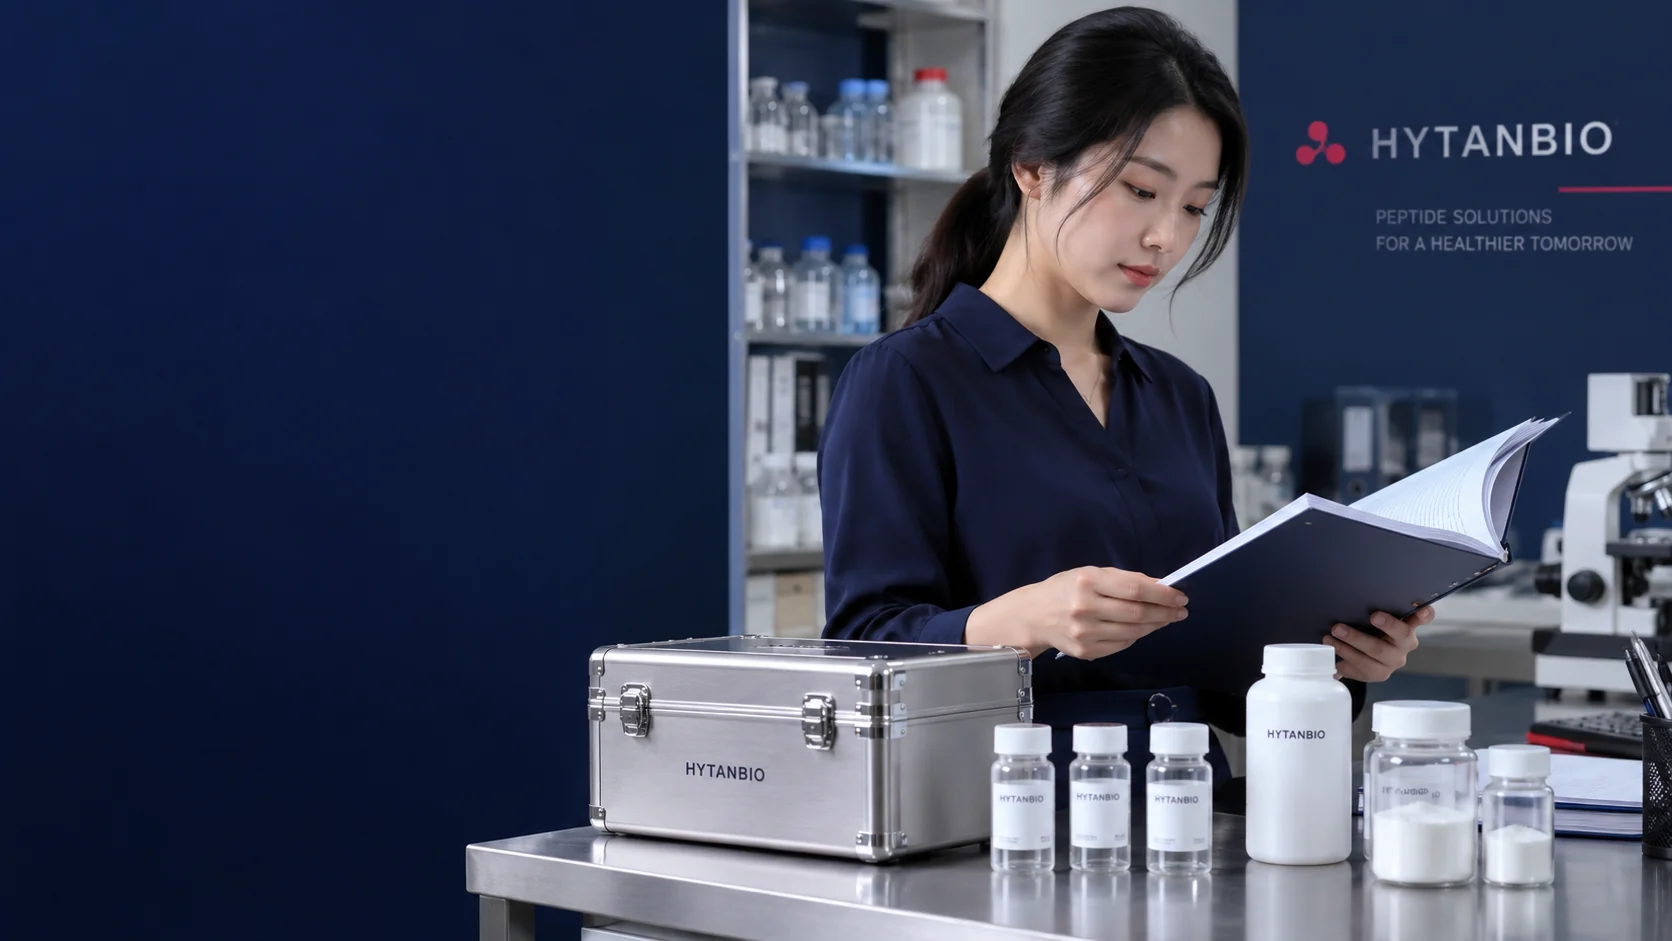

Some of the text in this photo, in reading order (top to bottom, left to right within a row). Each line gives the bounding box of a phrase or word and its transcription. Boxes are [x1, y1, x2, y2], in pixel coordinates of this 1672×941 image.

[1371, 121, 1612, 159] HYTANBIO
[1375, 209, 1553, 225] PEPTIDE SOLUTIONS
[1375, 235, 1634, 251] FOR A HEALTHIER TOMORROW
[1267, 729, 1326, 739] HYTANBIO
[685, 762, 765, 782] HYTANBIO
[1000, 795, 1044, 803] HYTANBIO
[1077, 793, 1120, 801] HYTANBIO
[1155, 795, 1199, 804] HYTANBIO
